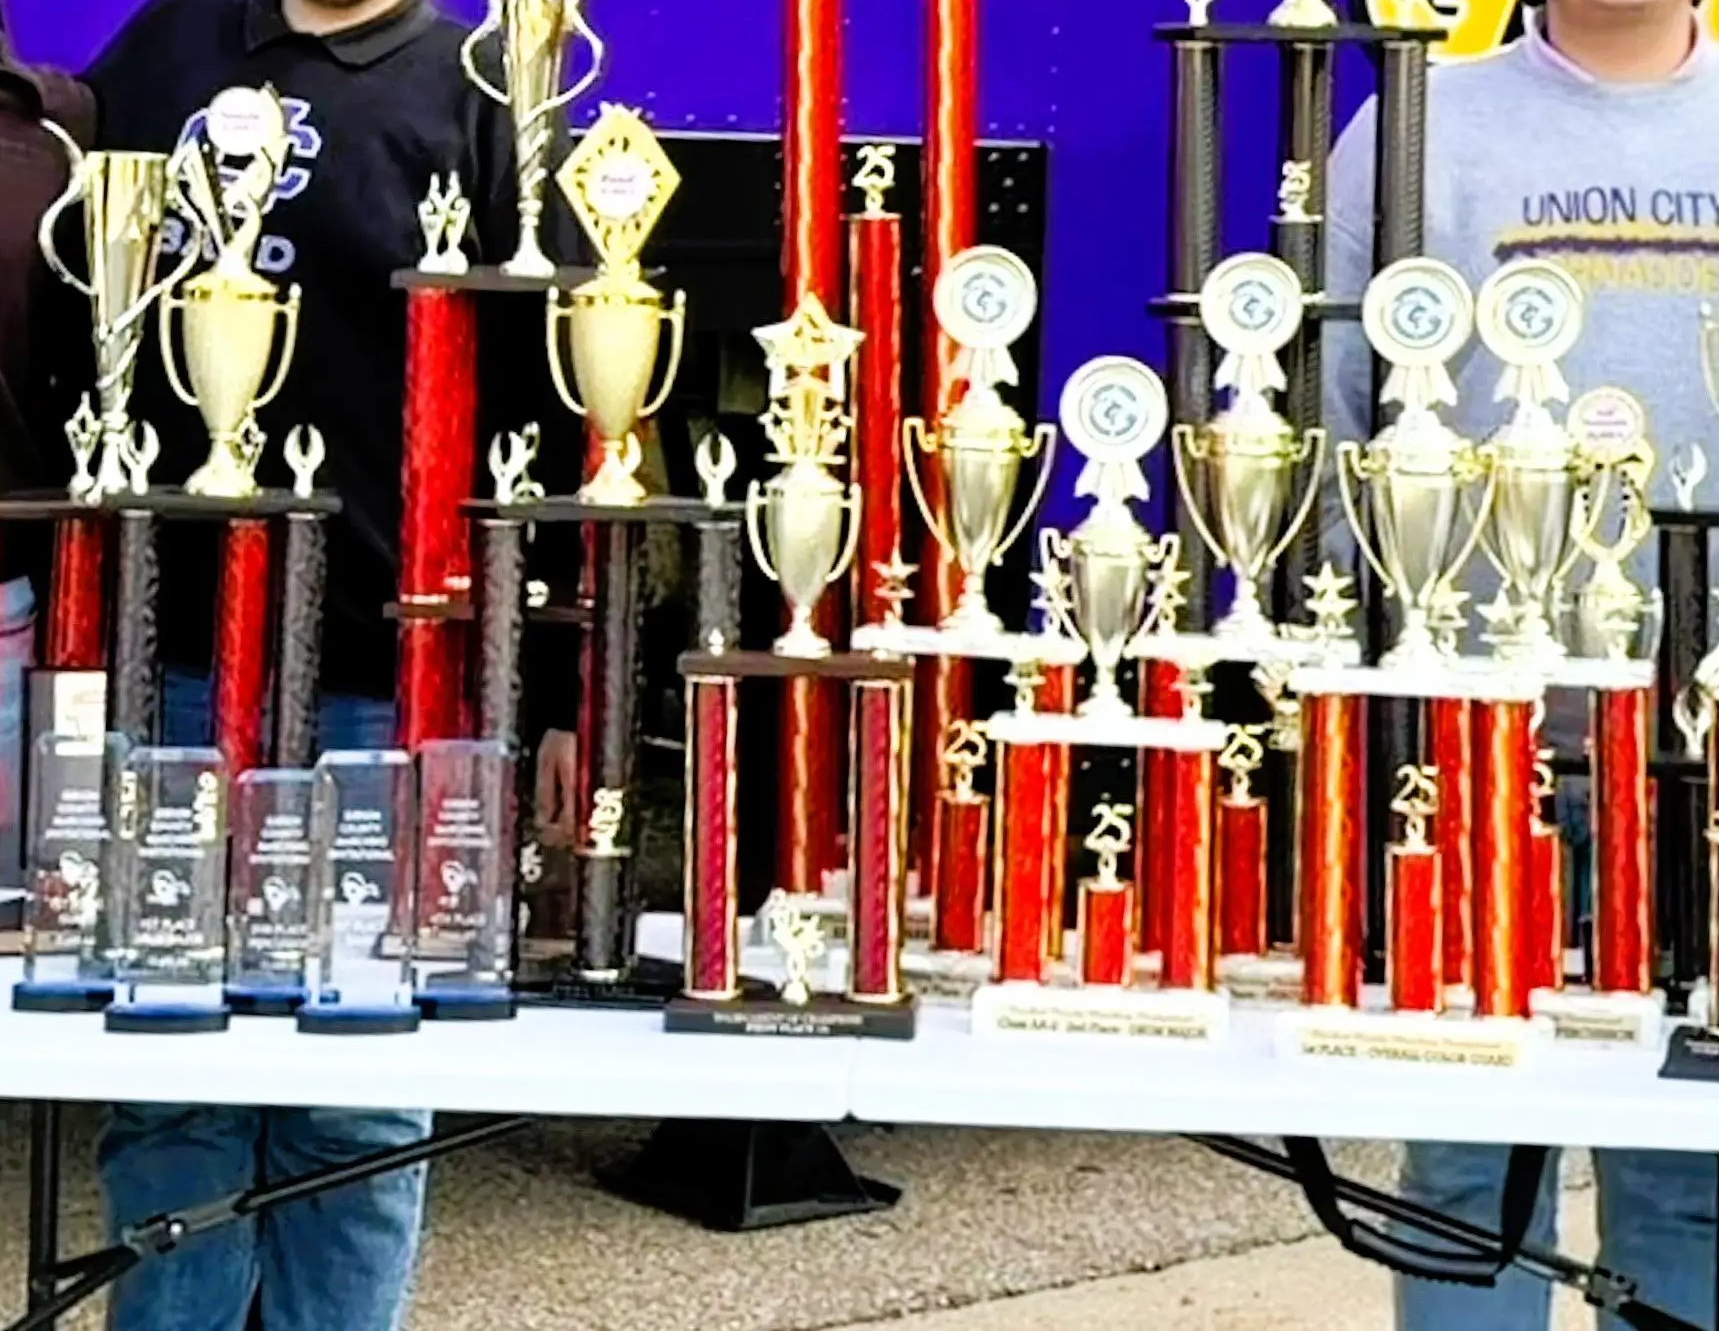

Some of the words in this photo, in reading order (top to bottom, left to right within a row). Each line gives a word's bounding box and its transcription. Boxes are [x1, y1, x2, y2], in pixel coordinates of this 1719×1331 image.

[851, 144, 896, 188] 25
[1522, 186, 1637, 227] UNION
[161, 216, 297, 274] BAD
[1390, 764, 1440, 815] 25
[1084, 802, 1135, 853] 25
